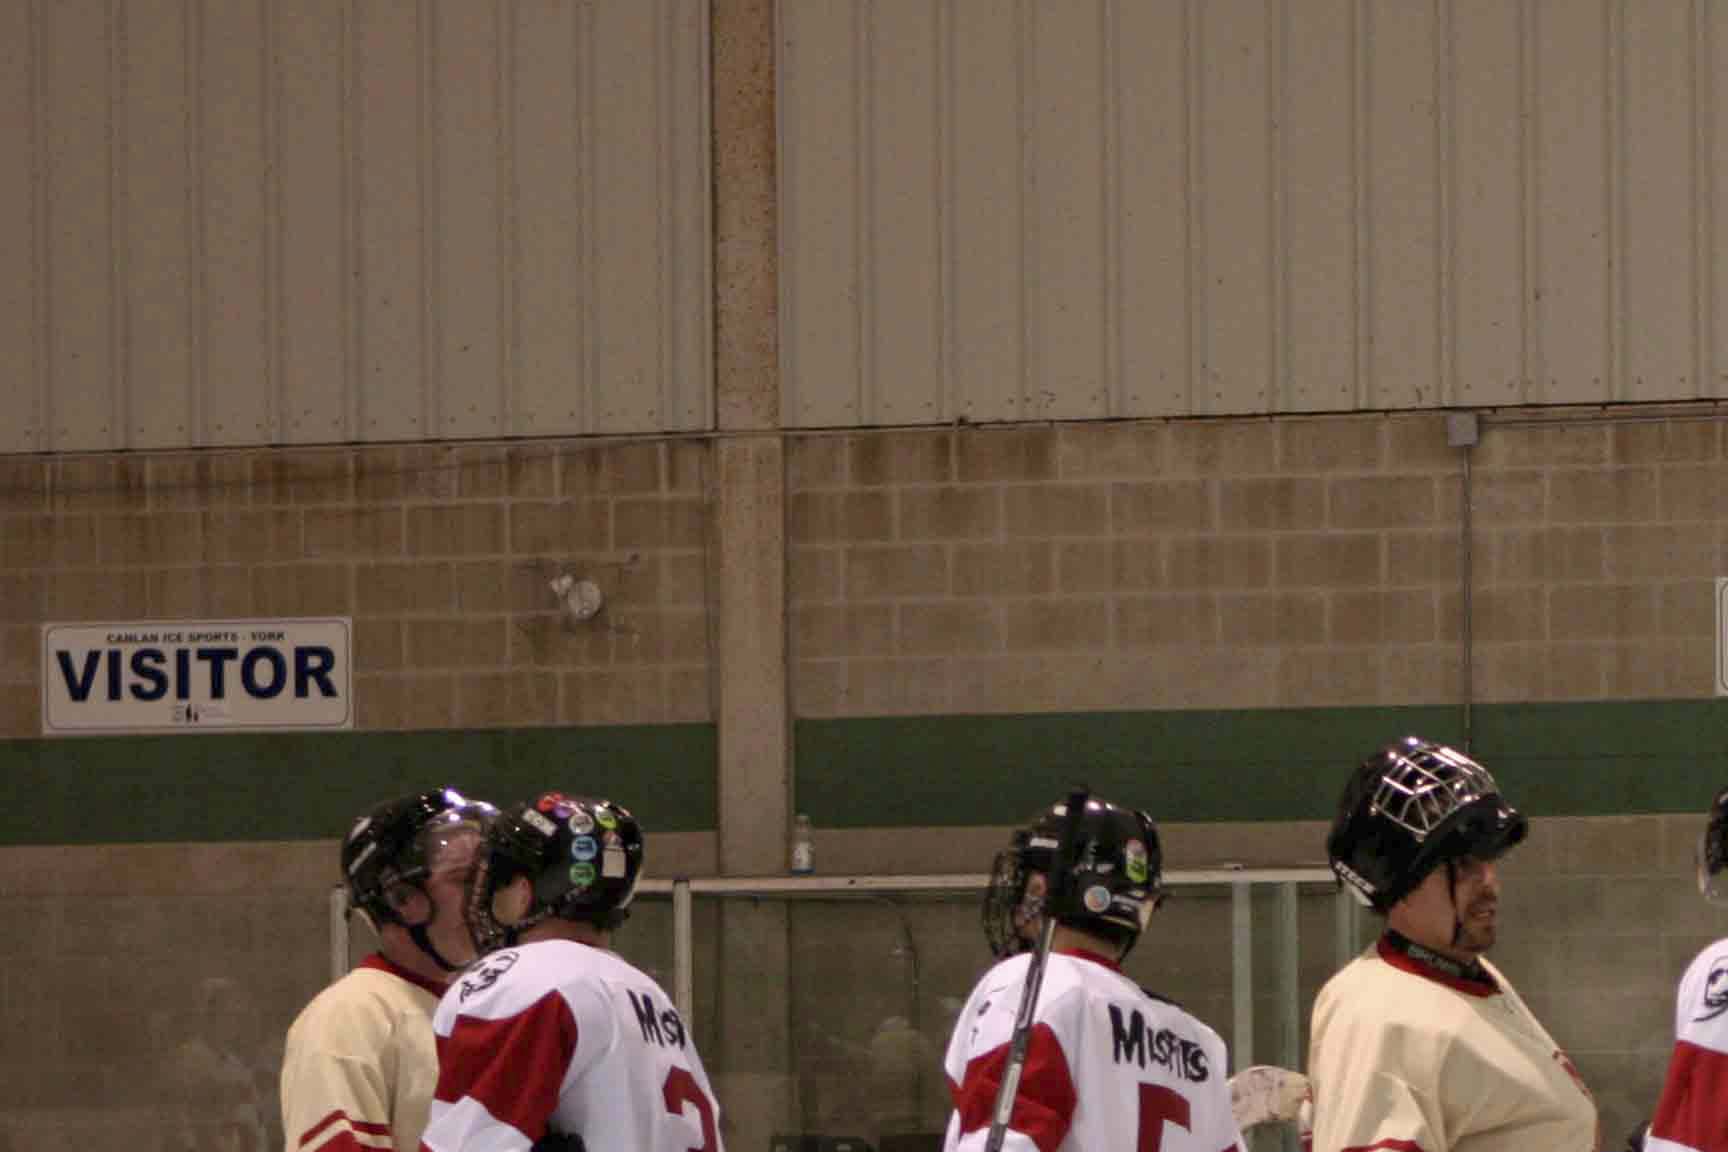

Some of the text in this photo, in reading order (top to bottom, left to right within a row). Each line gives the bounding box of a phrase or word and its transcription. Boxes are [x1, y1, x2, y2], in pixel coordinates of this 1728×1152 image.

[163, 632, 184, 642] ICE
[189, 631, 239, 642] SPORTS
[251, 631, 286, 641] YORK
[56, 646, 339, 702] VISITOR
